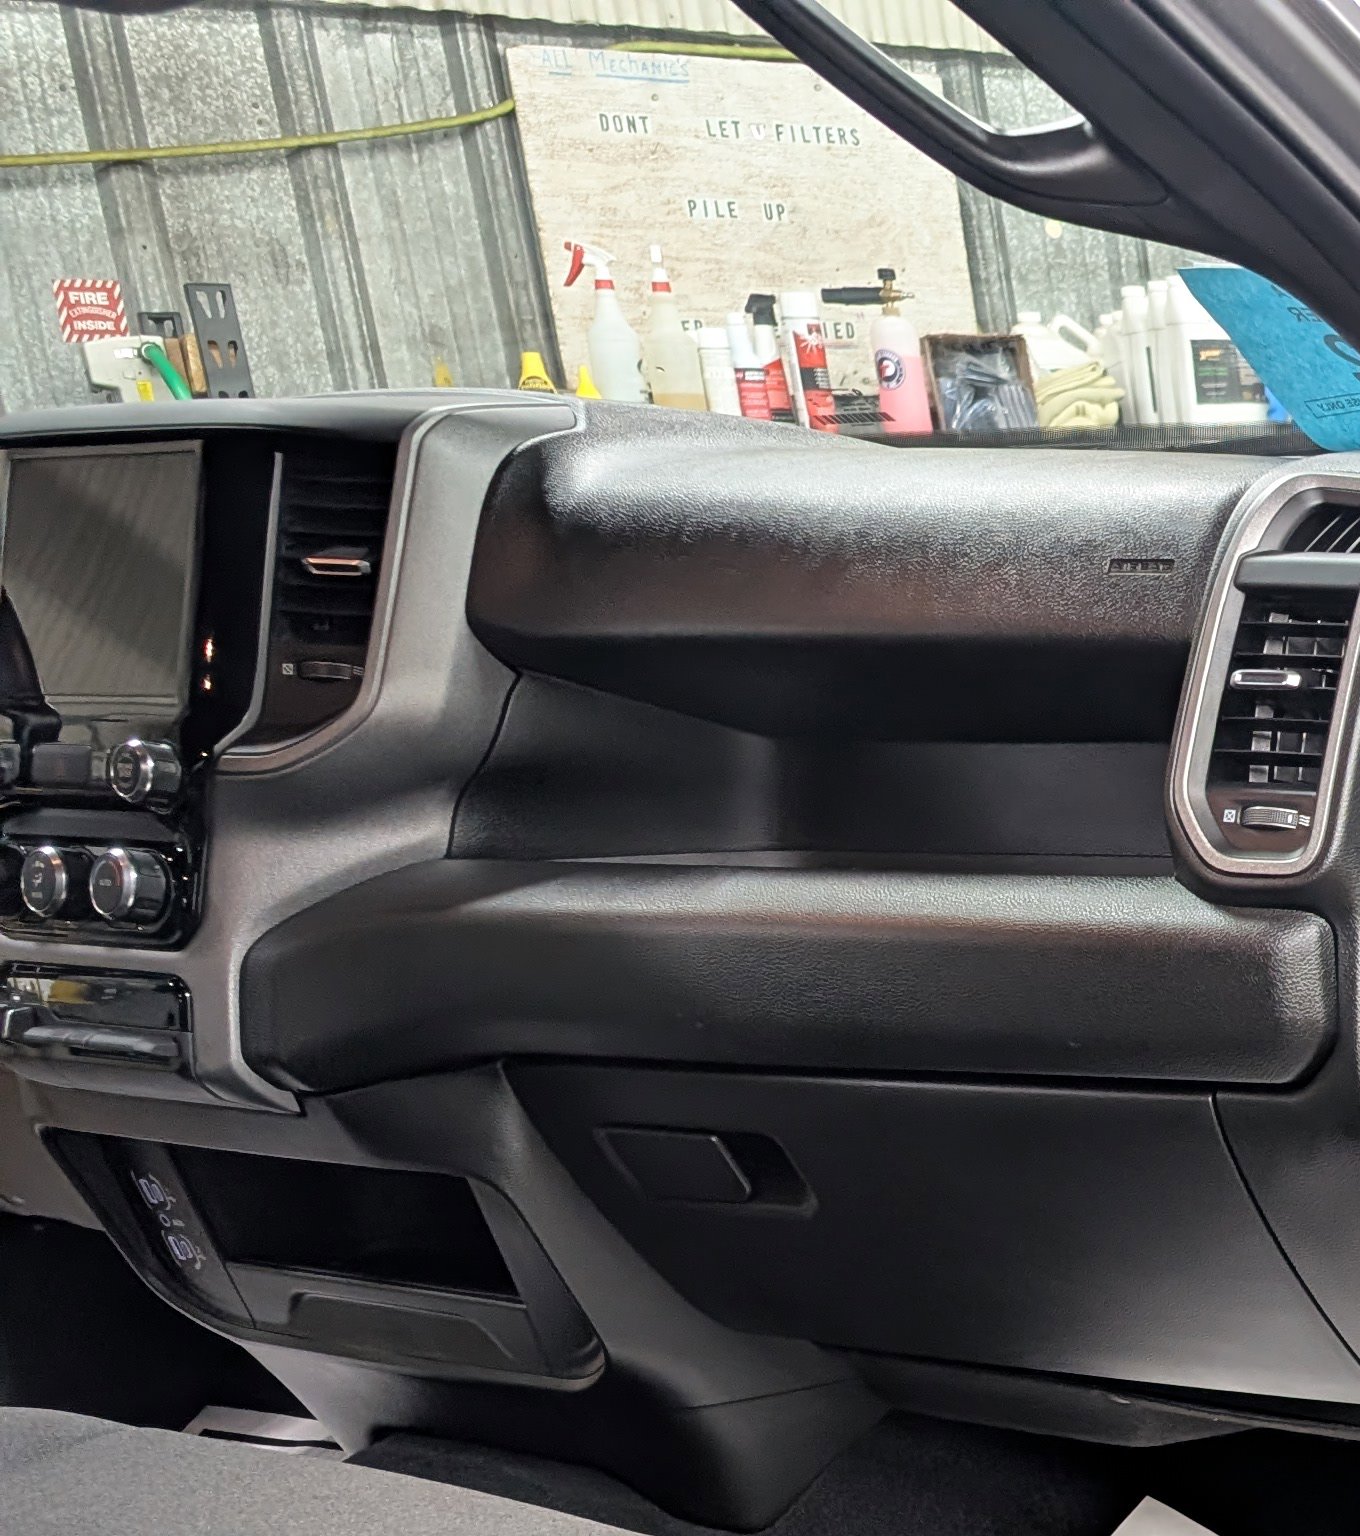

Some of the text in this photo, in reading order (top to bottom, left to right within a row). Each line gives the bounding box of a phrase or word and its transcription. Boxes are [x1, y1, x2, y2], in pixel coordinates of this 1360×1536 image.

[599, 113, 860, 147] DONT LET FILTERS
[687, 199, 786, 221] PILE UP
[68, 291, 110, 305] FIRE
[73, 320, 116, 331] INSIDE
